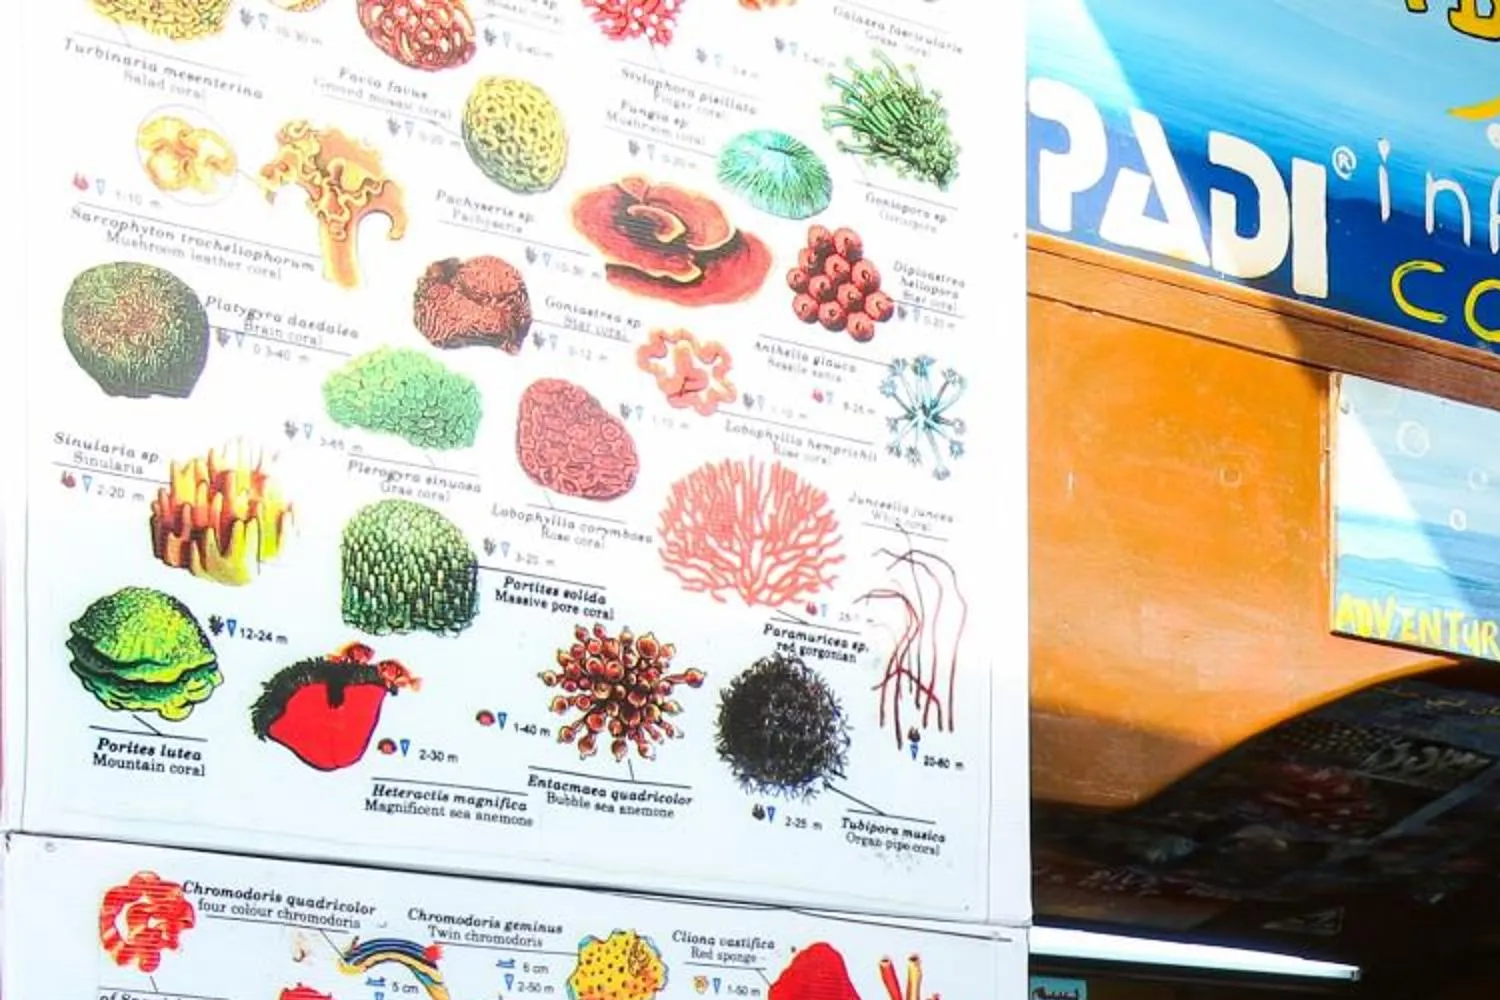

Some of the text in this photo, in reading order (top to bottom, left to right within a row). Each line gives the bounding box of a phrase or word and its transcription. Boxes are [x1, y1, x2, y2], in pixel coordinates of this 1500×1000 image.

[107, 230, 281, 281] Mushroom leather coral
[53, 431, 135, 459] Sinularia
[74, 451, 143, 475] Sinularia
[495, 588, 615, 621] Massive pore coral
[240, 627, 273, 644] 12-24
[763, 623, 848, 649] Paramuricea
[97, 737, 202, 761] Porites lutea
[419, 749, 444, 762] 2-30
[93, 752, 205, 776] Mountain coral
[547, 791, 674, 819] Bubble sea anemone
[610, 787, 693, 806] quadricolor
[365, 799, 534, 825] Magnificent sea anemone
[182, 880, 377, 917] Chromodoris quadricolor
[198, 898, 361, 929] four colour chromodoris
[407, 907, 563, 936] Chromodoris geminus
[428, 924, 543, 948] Twin chromodoris
[672, 930, 715, 947] Cliona
[690, 946, 757, 963] Red sponge
